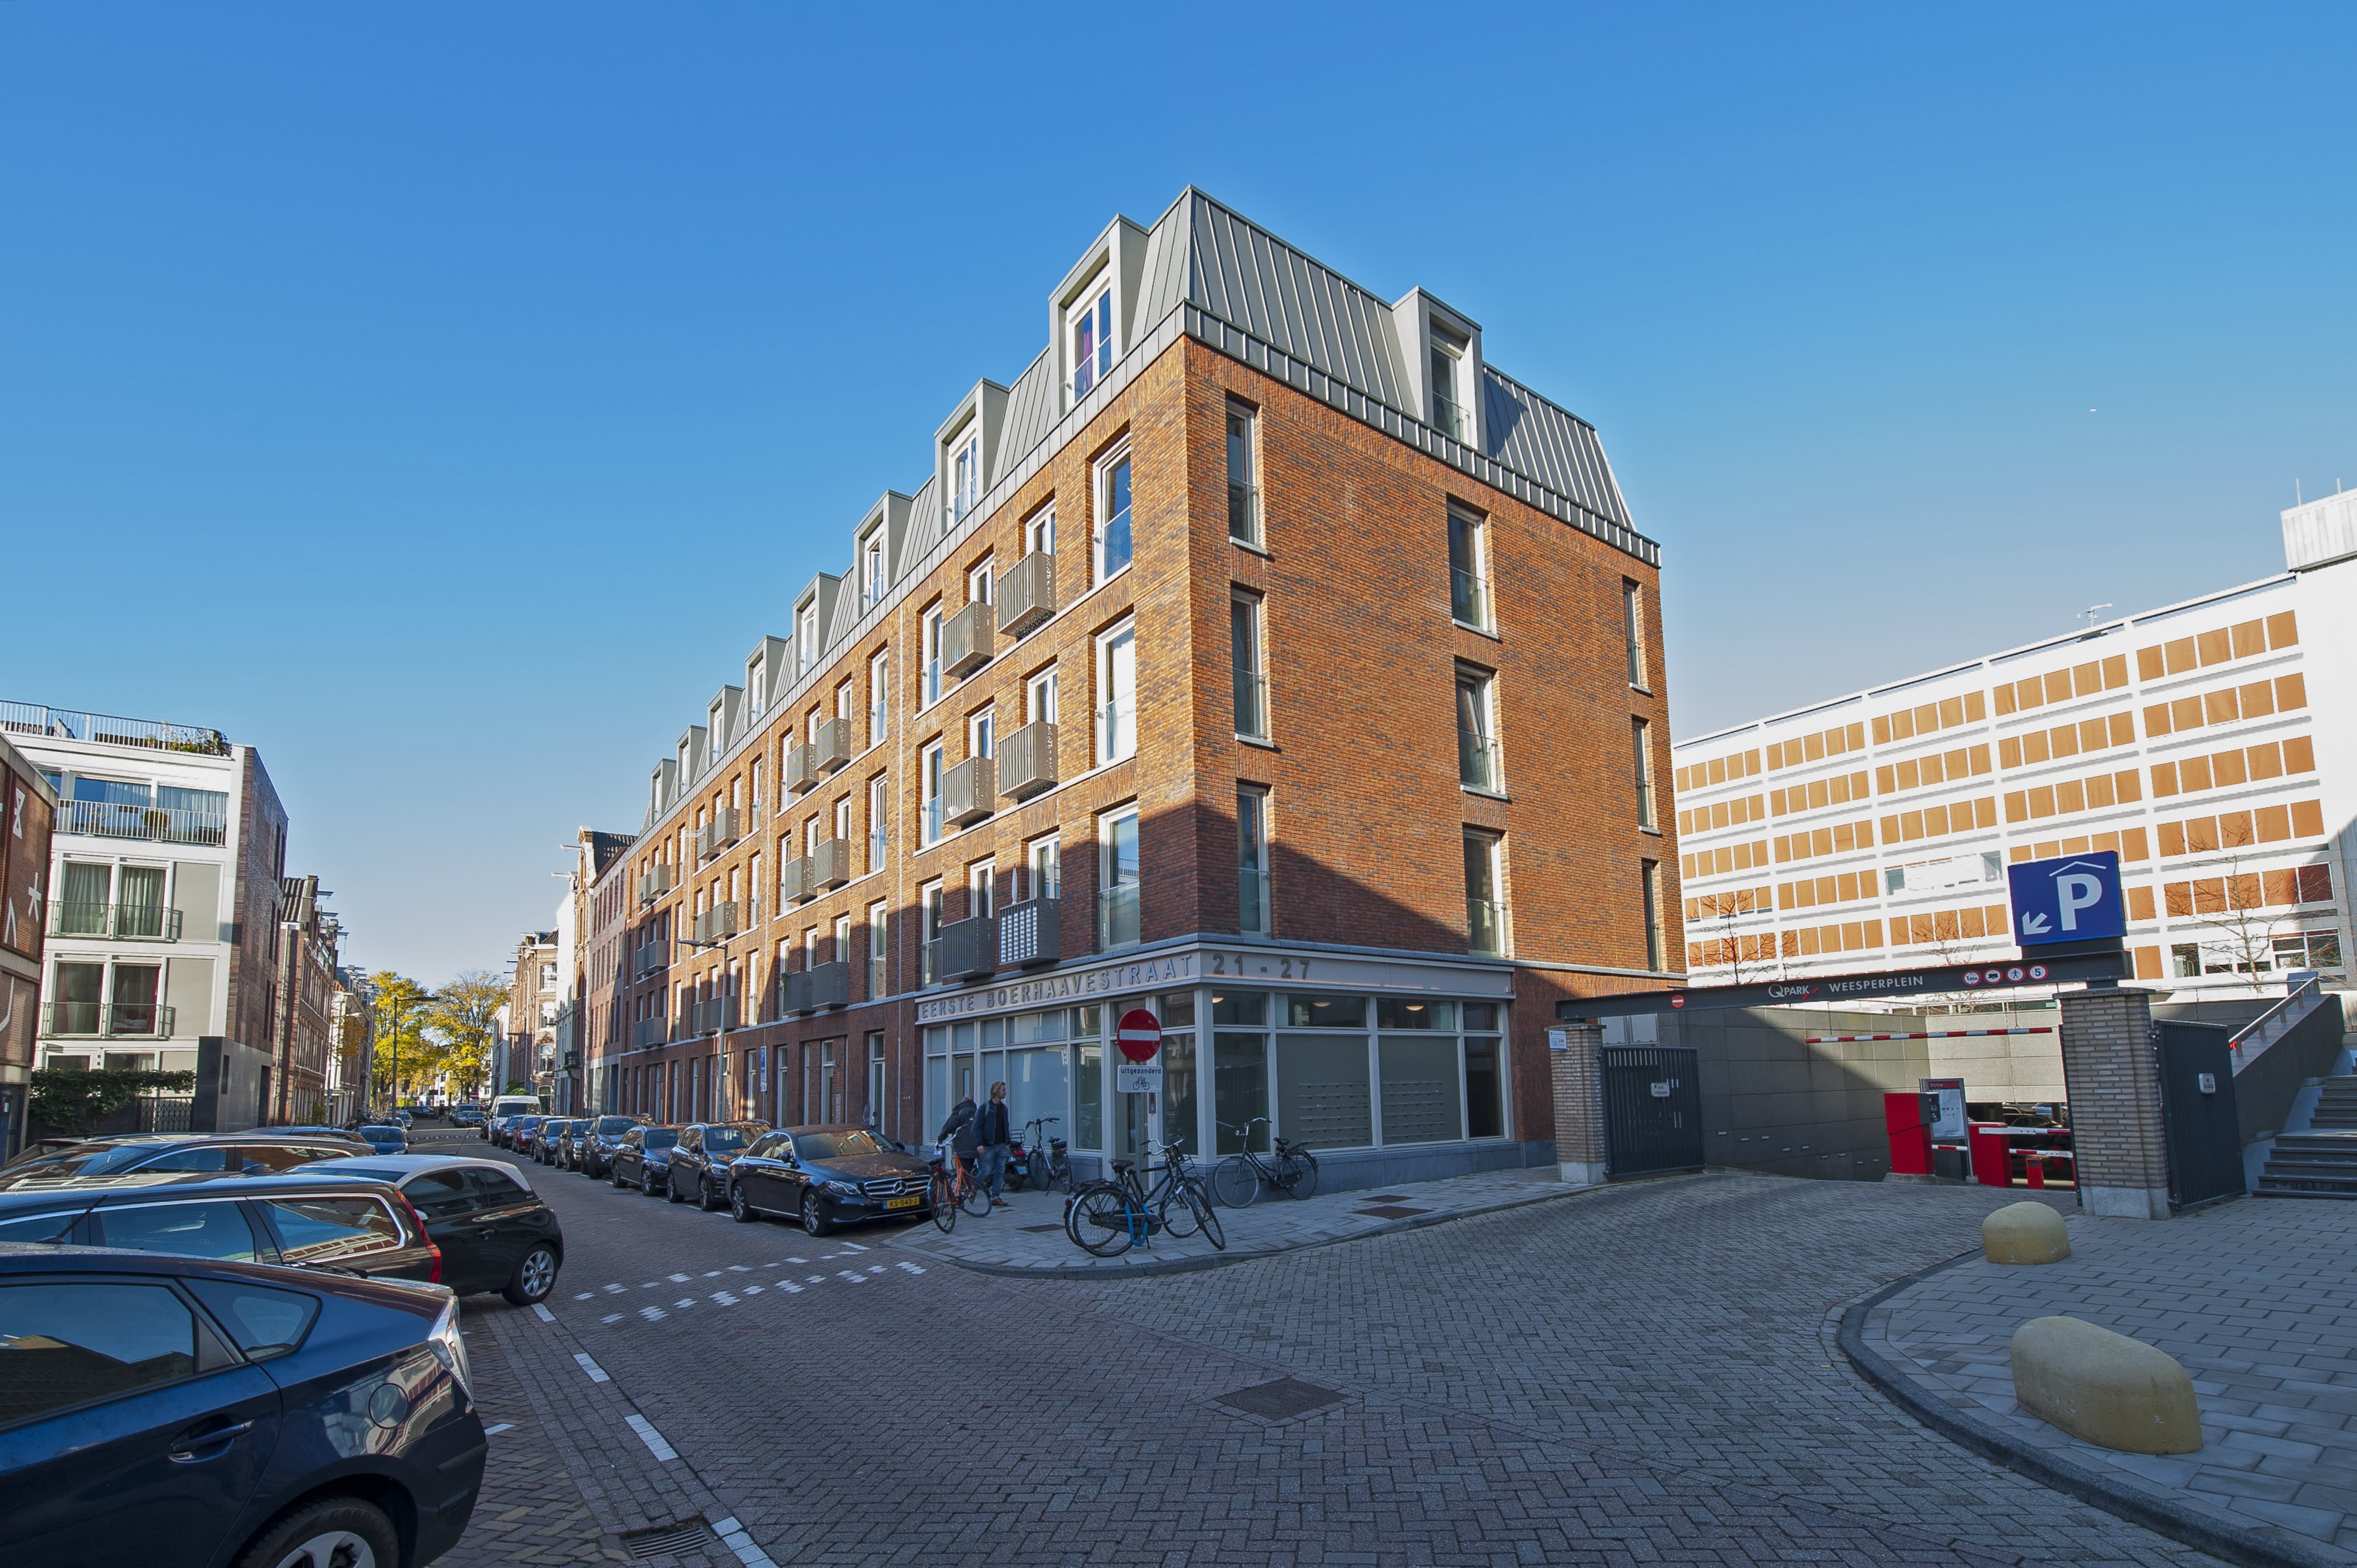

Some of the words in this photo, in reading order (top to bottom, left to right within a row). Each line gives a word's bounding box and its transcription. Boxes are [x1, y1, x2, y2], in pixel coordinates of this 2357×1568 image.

[2056, 873, 2102, 931] P
[1213, 953, 1243, 977] 21
[1280, 958, 1311, 979] 27
[2035, 969, 2041, 977] 5
[922, 995, 974, 1019] EERSTE
[986, 954, 1192, 1008] BOERHAAVESTRAAT
[1829, 975, 1924, 993] WEESPERPLEIN
[1121, 1067, 1161, 1075] uitgezonderd
[889, 1198, 917, 1207] KS-543-J
